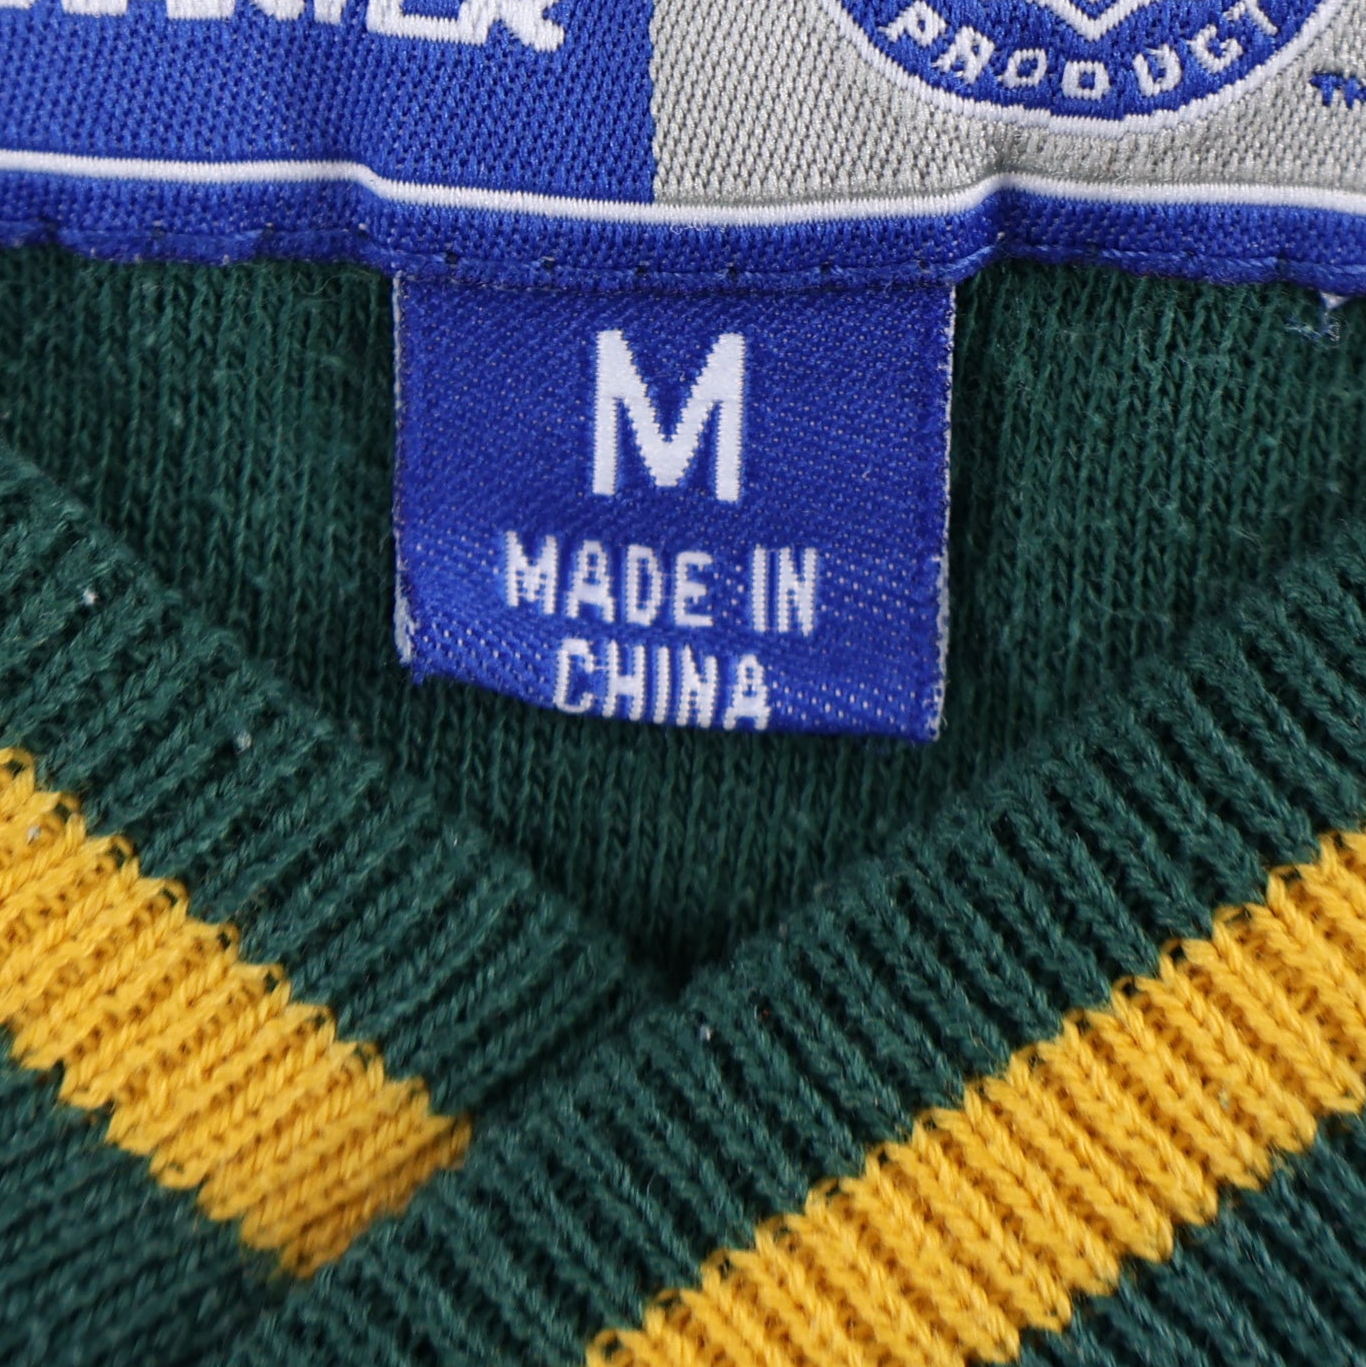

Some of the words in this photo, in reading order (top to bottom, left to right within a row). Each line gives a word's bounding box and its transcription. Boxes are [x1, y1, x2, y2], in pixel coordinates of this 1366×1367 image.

[591, 329, 746, 503] M
[503, 530, 714, 629] MADE
[750, 543, 820, 637] IN
[553, 637, 773, 731] CHINA
